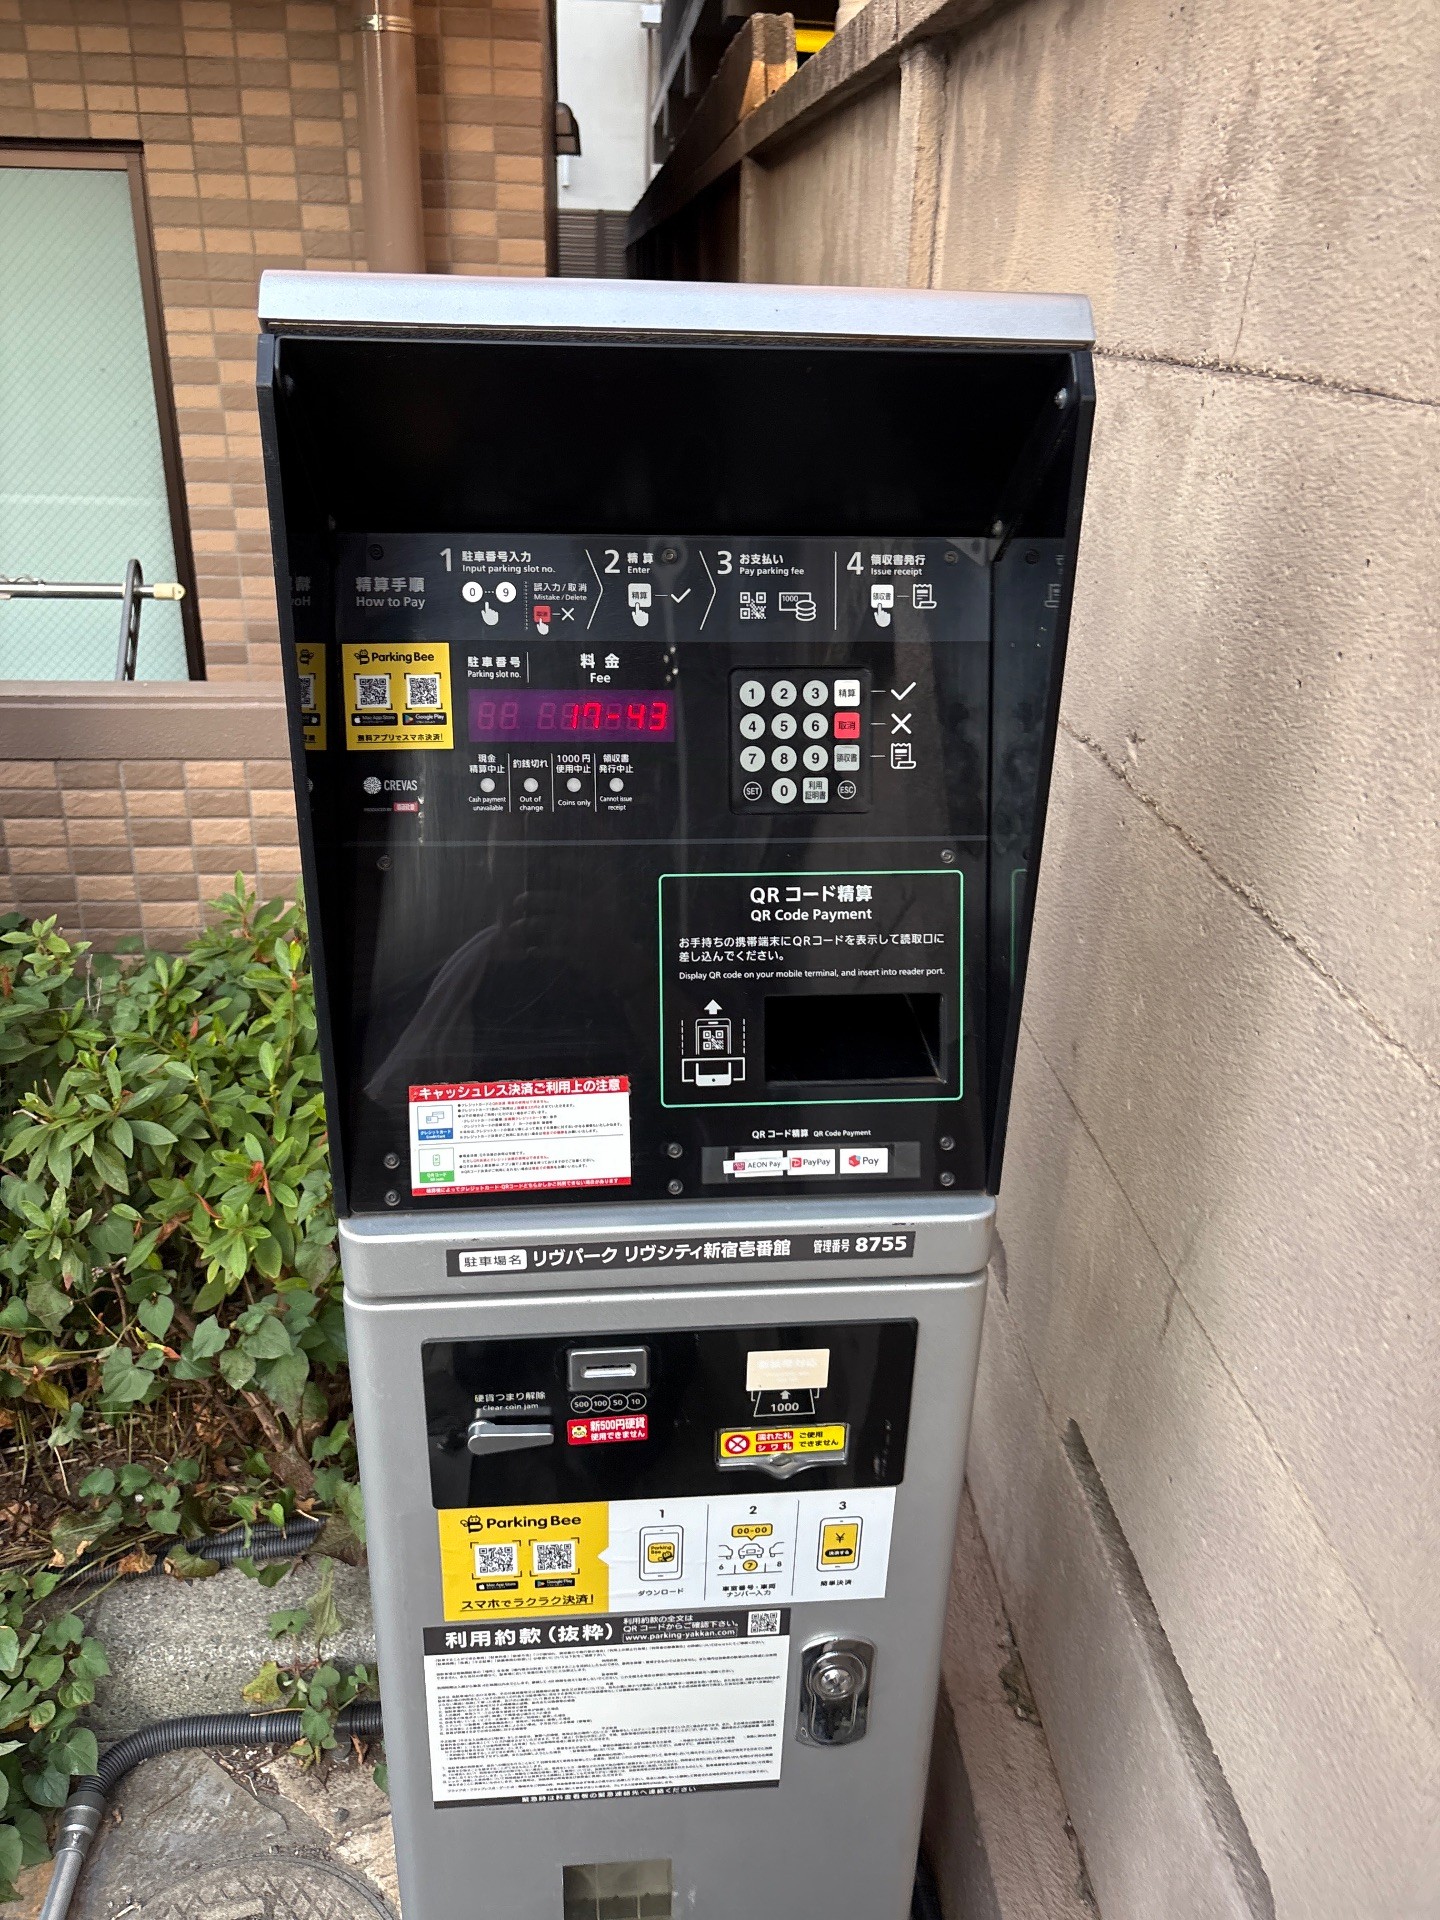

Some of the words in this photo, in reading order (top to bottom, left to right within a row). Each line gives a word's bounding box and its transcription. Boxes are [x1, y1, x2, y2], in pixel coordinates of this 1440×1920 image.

[440, 547, 452, 572] 1
[461, 551, 532, 563] 駐車番号入力
[604, 549, 621, 574] 2
[627, 552, 654, 564] 精算
[739, 553, 784, 565] お支払い
[871, 554, 926, 566] 領収書発行
[717, 550, 733, 575] 3
[846, 552, 864, 575] 4
[462, 565, 486, 573] Input
[488, 565, 522, 575] parking
[523, 565, 539, 573] slot
[627, 566, 650, 574] Enter
[739, 567, 755, 577] Pay
[757, 566, 789, 577] parking
[791, 566, 805, 575] fee
[893, 568, 923, 577] receipt
[355, 576, 425, 593] 精算手順
[632, 591, 648, 599] 精算
[356, 596, 385, 607] How
[388, 597, 401, 607] to
[403, 596, 426, 610] Pay
[371, 652, 412, 664] Parking
[413, 652, 435, 662] Bee
[467, 656, 521, 668] 駐車番号
[580, 653, 620, 669] 料金
[467, 670, 494, 680] Parking
[495, 670, 508, 678] slot
[590, 672, 611, 683] Fee
[748, 688, 755, 699] 1
[780, 688, 788, 699] 2
[811, 688, 820, 699] 3
[838, 689, 856, 698] 精算
[415, 713, 433, 721] Google
[433, 713, 445, 721] Play
[748, 721, 756, 732] 4
[780, 720, 788, 732] 5
[811, 720, 820, 732] 6
[838, 721, 856, 730] 取消
[478, 754, 497, 763] 現金
[603, 754, 630, 763] 領収書
[748, 753, 757, 765] 7
[780, 753, 788, 765] 8
[811, 753, 820, 764] 9
[836, 753, 857, 762] 領収書
[512, 759, 549, 769] 釣銭切れ
[469, 765, 505, 774] 精算中止
[556, 765, 591, 774] 使用中止
[599, 765, 634, 774] 発行中止
[383, 779, 418, 791] CREVAS
[808, 781, 823, 789] 利用
[840, 786, 854, 794] ESC
[746, 787, 760, 795] SET
[780, 785, 788, 797] 0
[805, 790, 826, 800] 証明書
[482, 796, 506, 804] payment
[577, 800, 591, 808] only
[519, 804, 544, 812] change
[608, 804, 627, 812] receipt
[750, 909, 772, 922] QR
[774, 909, 809, 921] Code
[812, 908, 873, 923] Payment
[679, 933, 945, 949] お手持ちの携帯端末にQRコードを表示して読取口に
[679, 950, 784, 963] 差し込んでください。
[679, 971, 707, 981] Display
[708, 971, 721, 979] QR
[723, 971, 742, 979] code
[744, 971, 755, 979] on
[756, 971, 774, 980] your
[776, 969, 803, 978] mobile
[804, 968, 839, 978] terminal,
[841, 968, 856, 977] and
[858, 968, 880, 976] insert
[881, 968, 897, 976] into
[898, 967, 925, 976] reader
[926, 967, 946, 977] port.
[419, 1078, 621, 1100] キャッシュレス決済ご利用上の注意
[824, 1129, 841, 1137] Code
[842, 1129, 872, 1138] Payment
[747, 1161, 768, 1169] AEON
[802, 1158, 831, 1166] PayPay
[862, 1156, 879, 1167] Pay
[464, 1254, 522, 1268] 駐車場名
[533, 1247, 618, 1267] リヴパーク
[625, 1239, 791, 1262] リヴシティ新宿壱番館
[813, 1239, 850, 1254] 管理番号
[855, 1236, 907, 1253] 8755
[474, 1390, 546, 1403] 硬貨つまり解除
[770, 1402, 800, 1412] 1000
[590, 1416, 646, 1432] 新500円硬貨
[590, 1430, 646, 1442] 使用できません
[799, 1431, 824, 1439] ご使用
[757, 1442, 792, 1451] シワ札
[799, 1439, 839, 1448] できません
[749, 1505, 758, 1515] 2
[838, 1500, 847, 1510] 3
[659, 1508, 665, 1518] 1
[486, 1516, 548, 1530] Parking
[550, 1515, 582, 1526] Bee
[638, 1588, 684, 1596] ダウンロード
[726, 1589, 771, 1597] ナンバー入力
[462, 1593, 594, 1610] スマホでラクラク決済!
[623, 1614, 694, 1624] 利用約款の全文は
[625, 1628, 736, 1642] www.parking-yakkan.com
